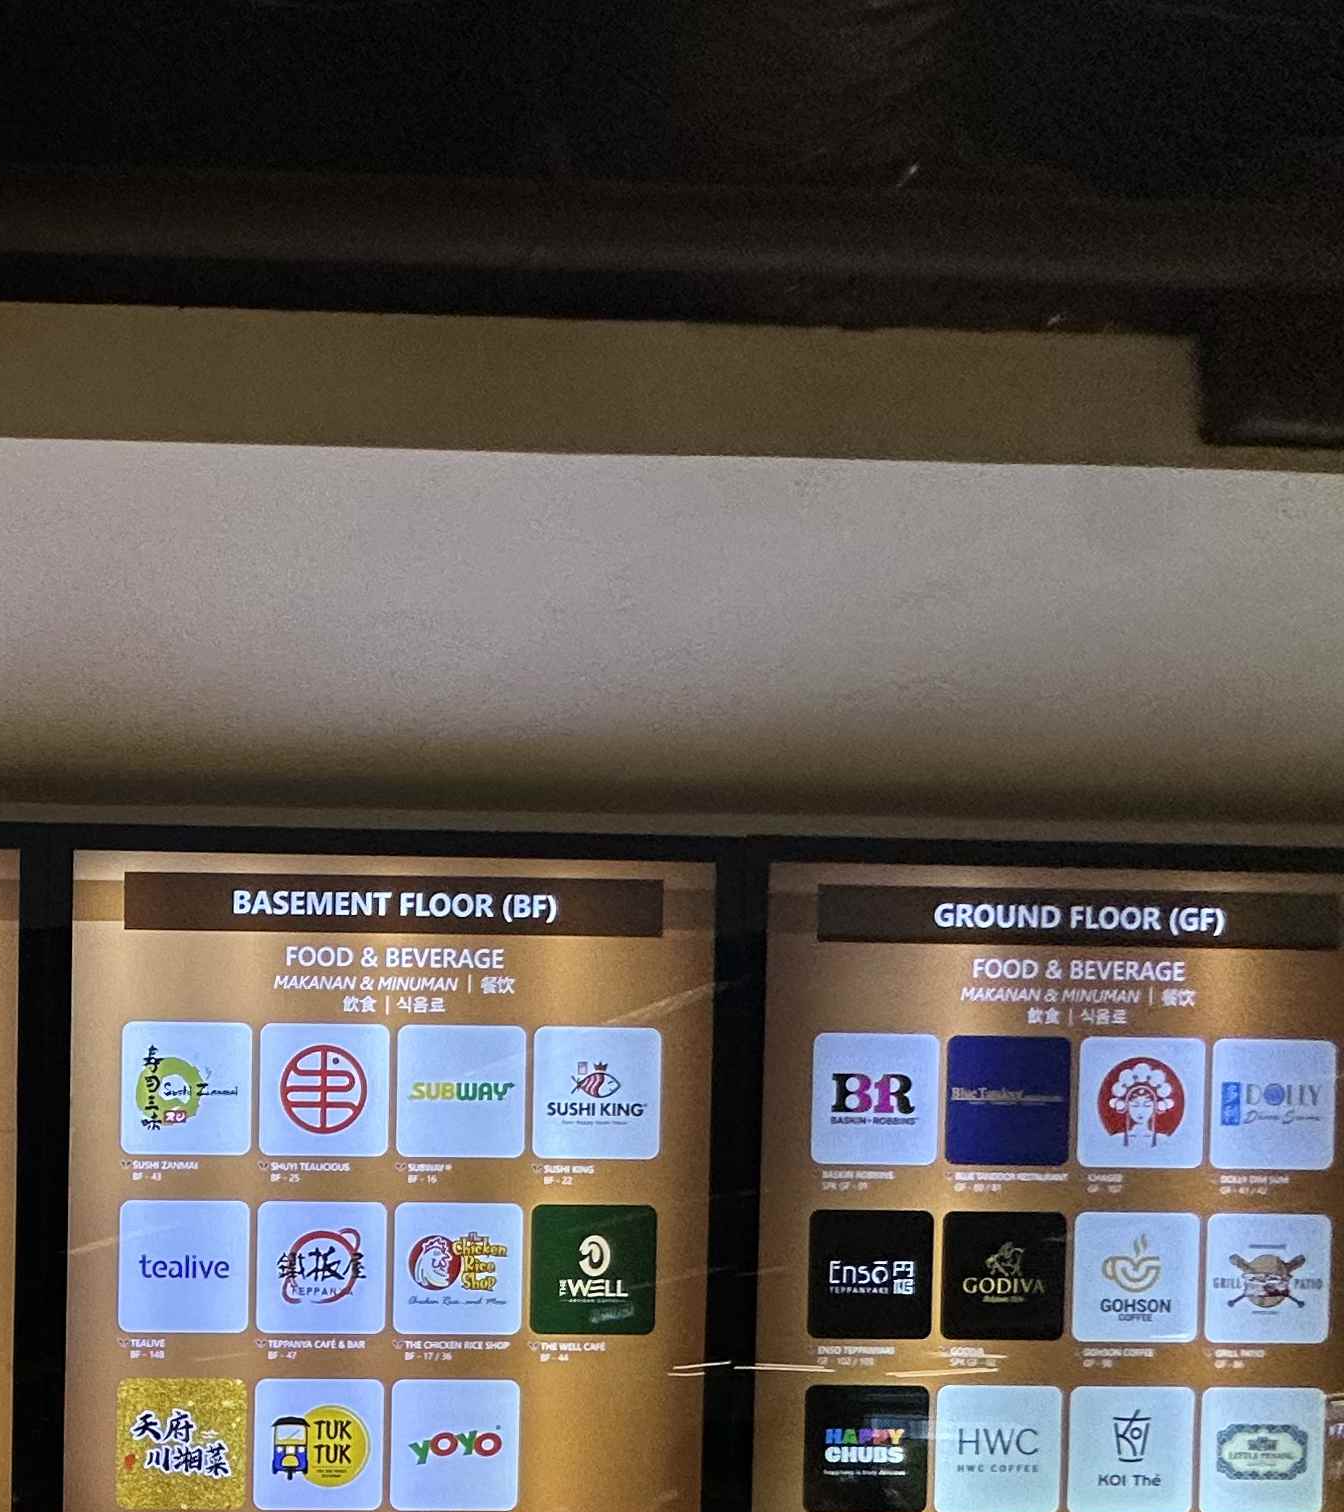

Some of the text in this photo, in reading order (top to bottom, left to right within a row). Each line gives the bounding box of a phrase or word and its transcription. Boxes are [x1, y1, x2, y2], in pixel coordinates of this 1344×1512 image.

[234, 890, 558, 923] BASEMENT FLOOR (BF)
[935, 903, 1225, 936] GROUND FLOOR (GF)
[972, 959, 1186, 981] FOOD & BEVERAGE
[411, 1082, 512, 1101] SUBWAY
[548, 1102, 644, 1117] SUSHI KING
[132, 1160, 159, 1169] SUSHI
[139, 1255, 229, 1278] tealive
[569, 1279, 628, 1297] WELL
[963, 1278, 1043, 1297] GODIVA
[1100, 1298, 1171, 1314] GOHSON
[1118, 1314, 1153, 1322] COFFEE
[314, 1420, 352, 1440] TUK
[959, 1429, 1038, 1455] HWC
[314, 1444, 351, 1464] TUK
[825, 1443, 906, 1463] CHUBS
[1098, 1475, 1126, 1486] KOI
